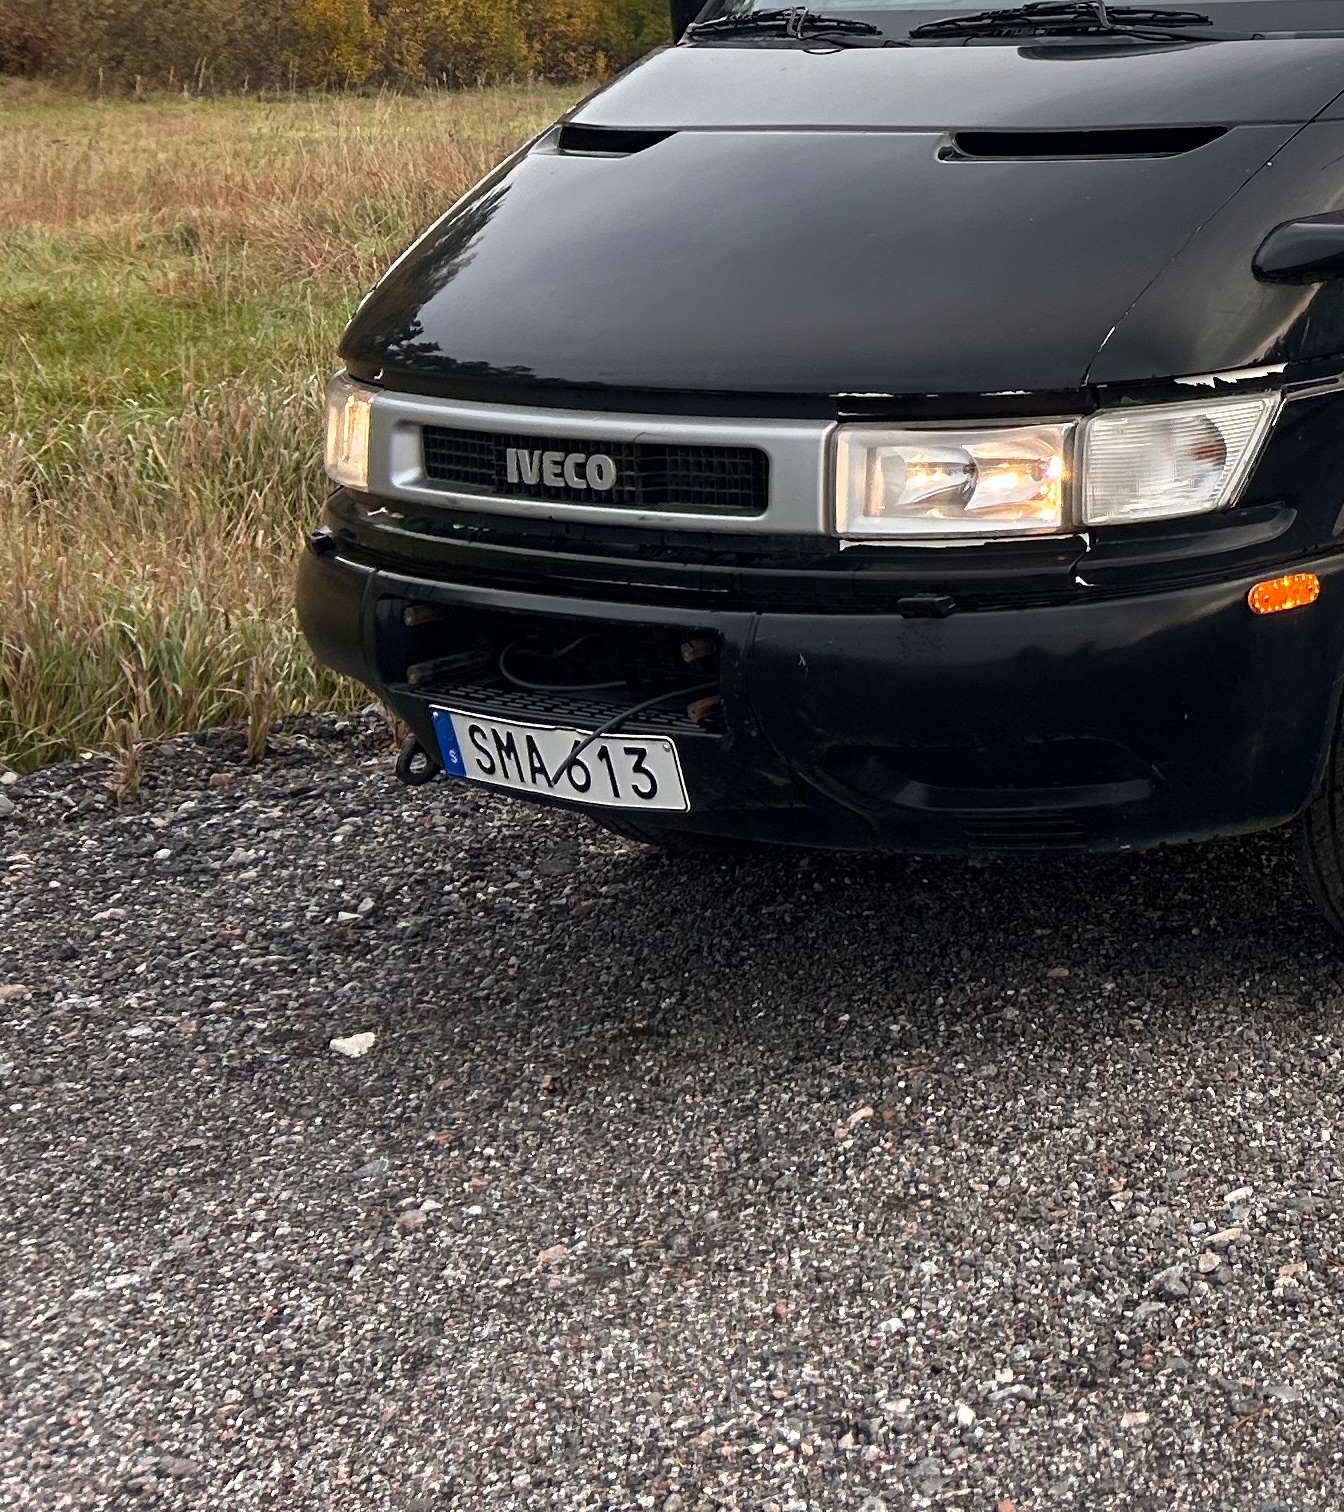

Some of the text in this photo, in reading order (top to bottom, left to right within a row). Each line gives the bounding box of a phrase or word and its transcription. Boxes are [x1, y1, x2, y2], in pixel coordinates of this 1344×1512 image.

[506, 448, 617, 491] IVECO
[449, 749, 458, 764] S
[468, 723, 658, 800] SMA 613
